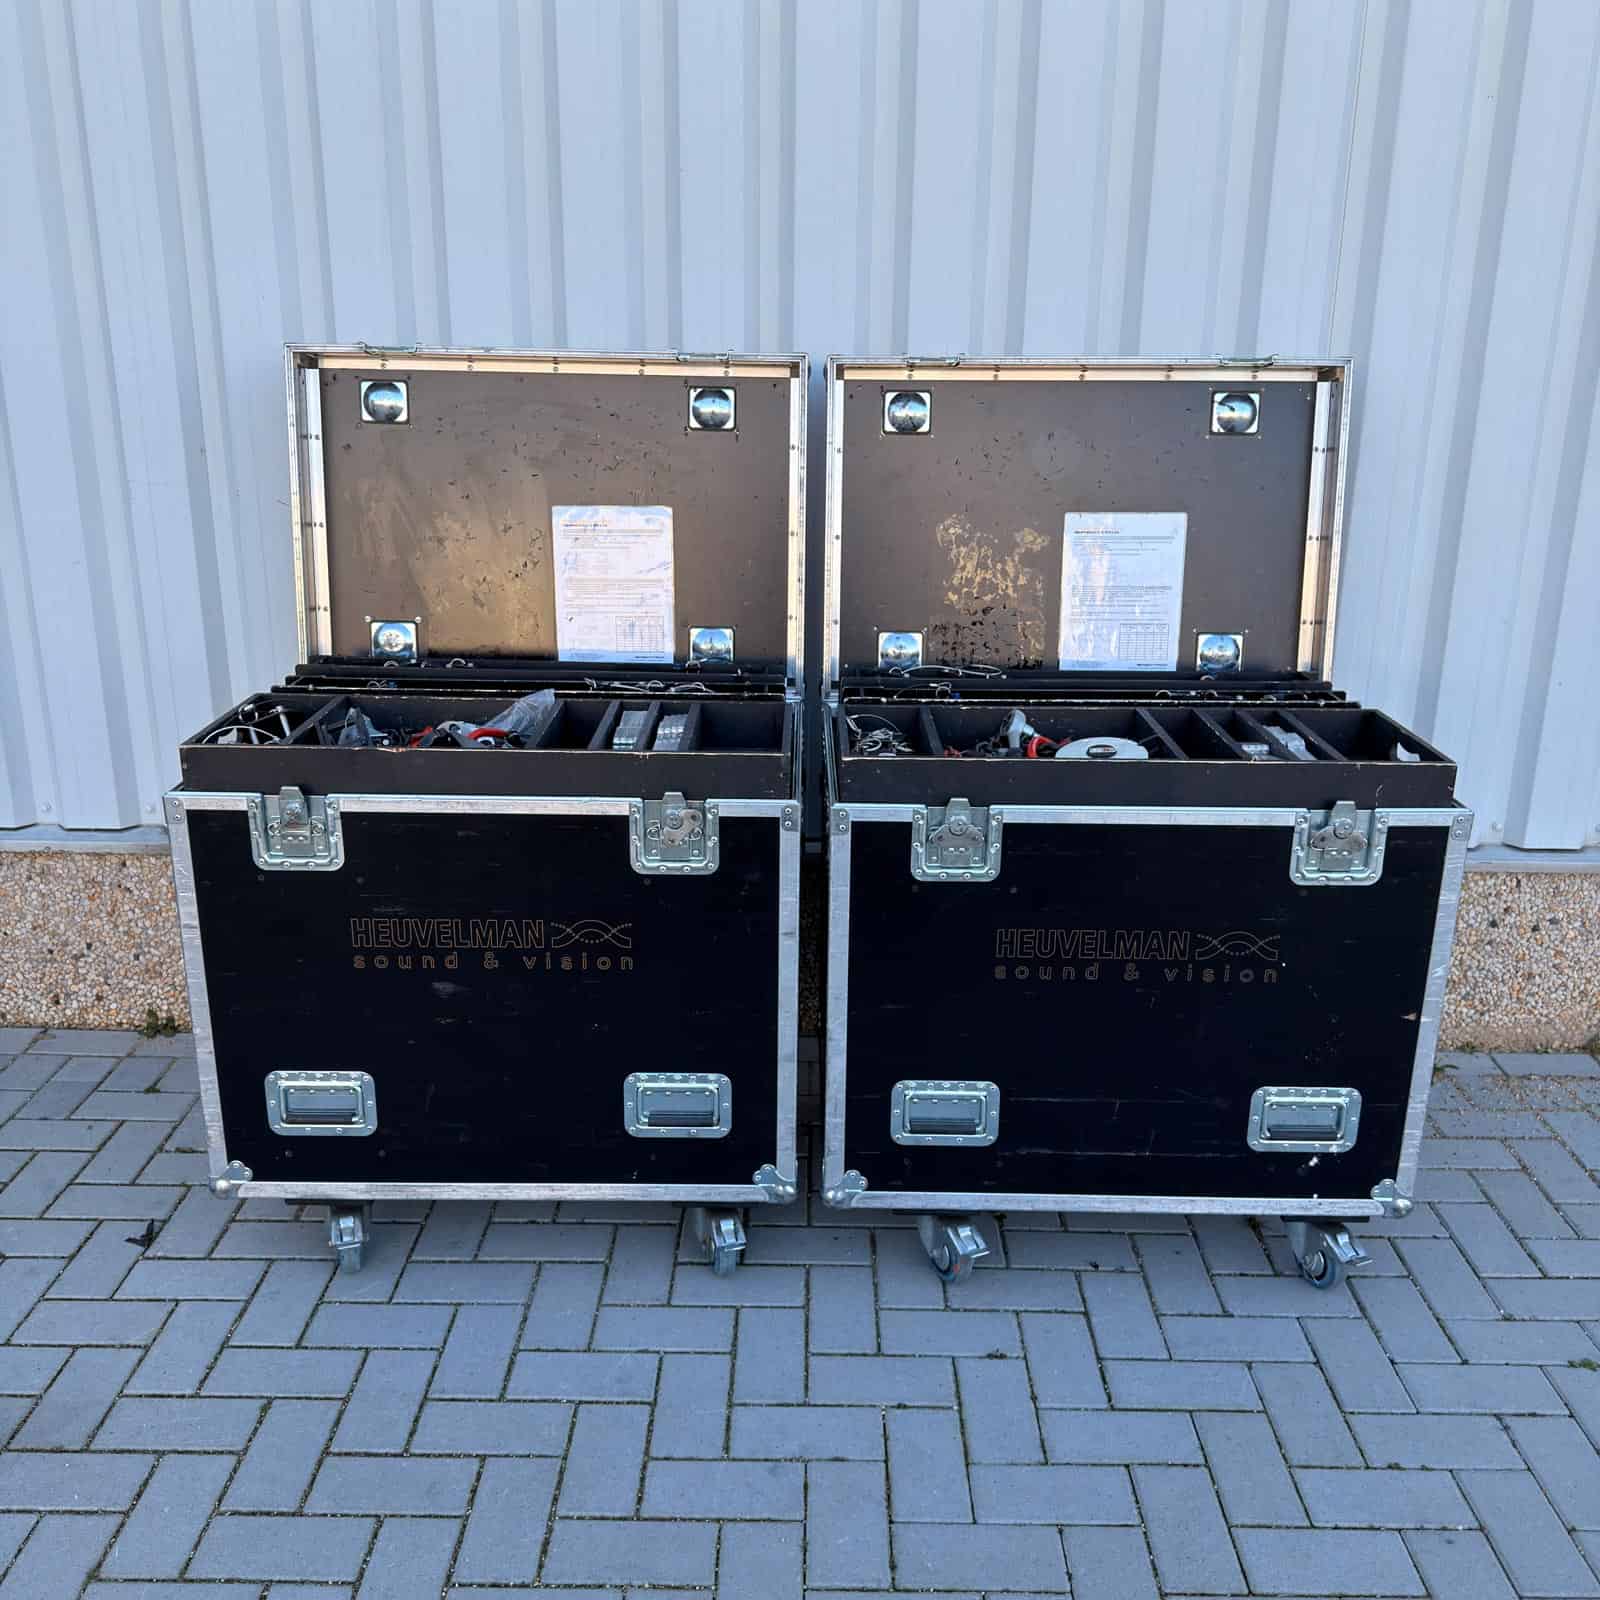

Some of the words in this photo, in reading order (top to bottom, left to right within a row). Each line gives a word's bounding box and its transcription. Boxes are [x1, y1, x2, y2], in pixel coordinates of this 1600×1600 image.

[350, 918, 545, 949] HEUVELMAN
[995, 928, 1191, 960] HEUVELMAN
[353, 951, 458, 969] sound
[483, 951, 499, 969] &
[523, 952, 634, 970] vision
[994, 962, 1099, 981] sound
[1123, 962, 1140, 981] &
[1164, 963, 1278, 983] vision
